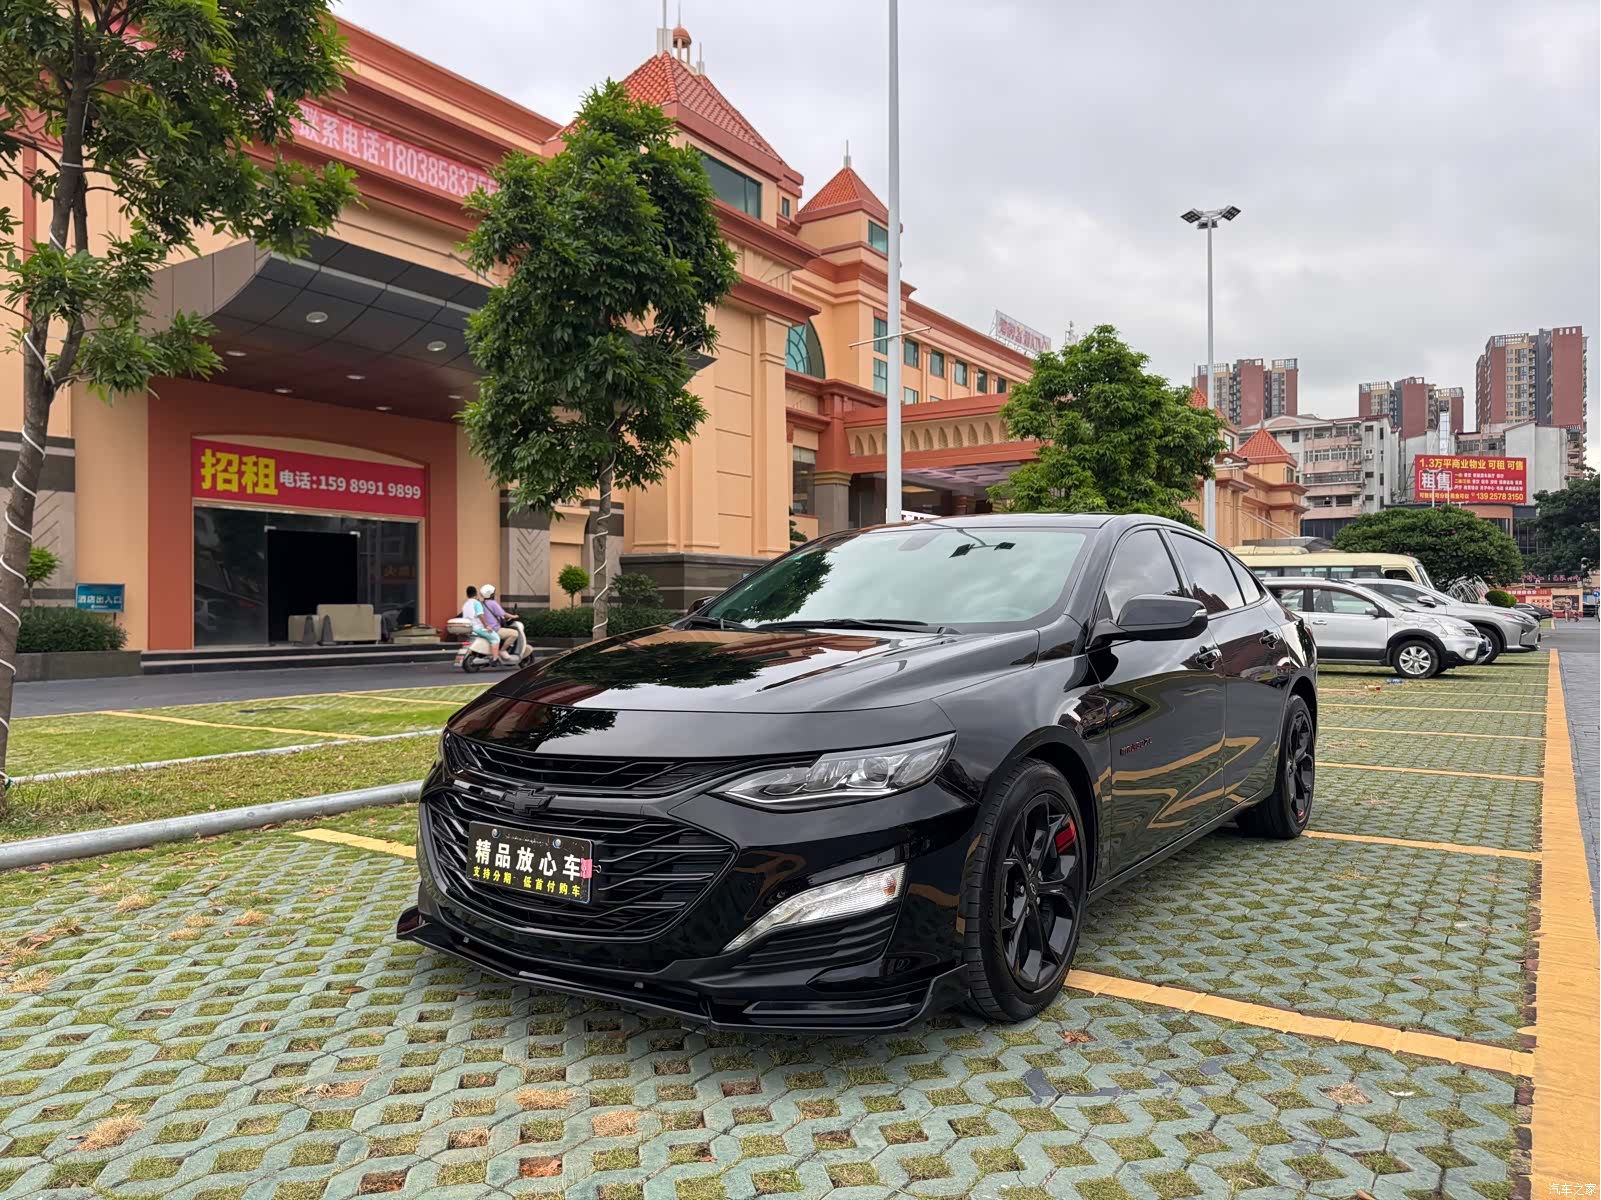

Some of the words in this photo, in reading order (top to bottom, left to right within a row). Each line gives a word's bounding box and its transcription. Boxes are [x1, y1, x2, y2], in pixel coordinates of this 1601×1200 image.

[201, 449, 278, 495] 招租
[279, 469, 346, 491] 电话:159
[349, 479, 385, 496] 8991
[388, 482, 422, 499] 9899
[1419, 458, 1486, 469] 1.3万平商业物业
[1488, 460, 1505, 470] 可租
[1422, 472, 1450, 490] 租售
[1476, 492, 1489, 500] 139
[1507, 493, 1524, 501] 3150
[475, 838, 581, 881] 精品放心车
[473, 866, 512, 884] 支持分期
[523, 875, 581, 898] 低首付购车
